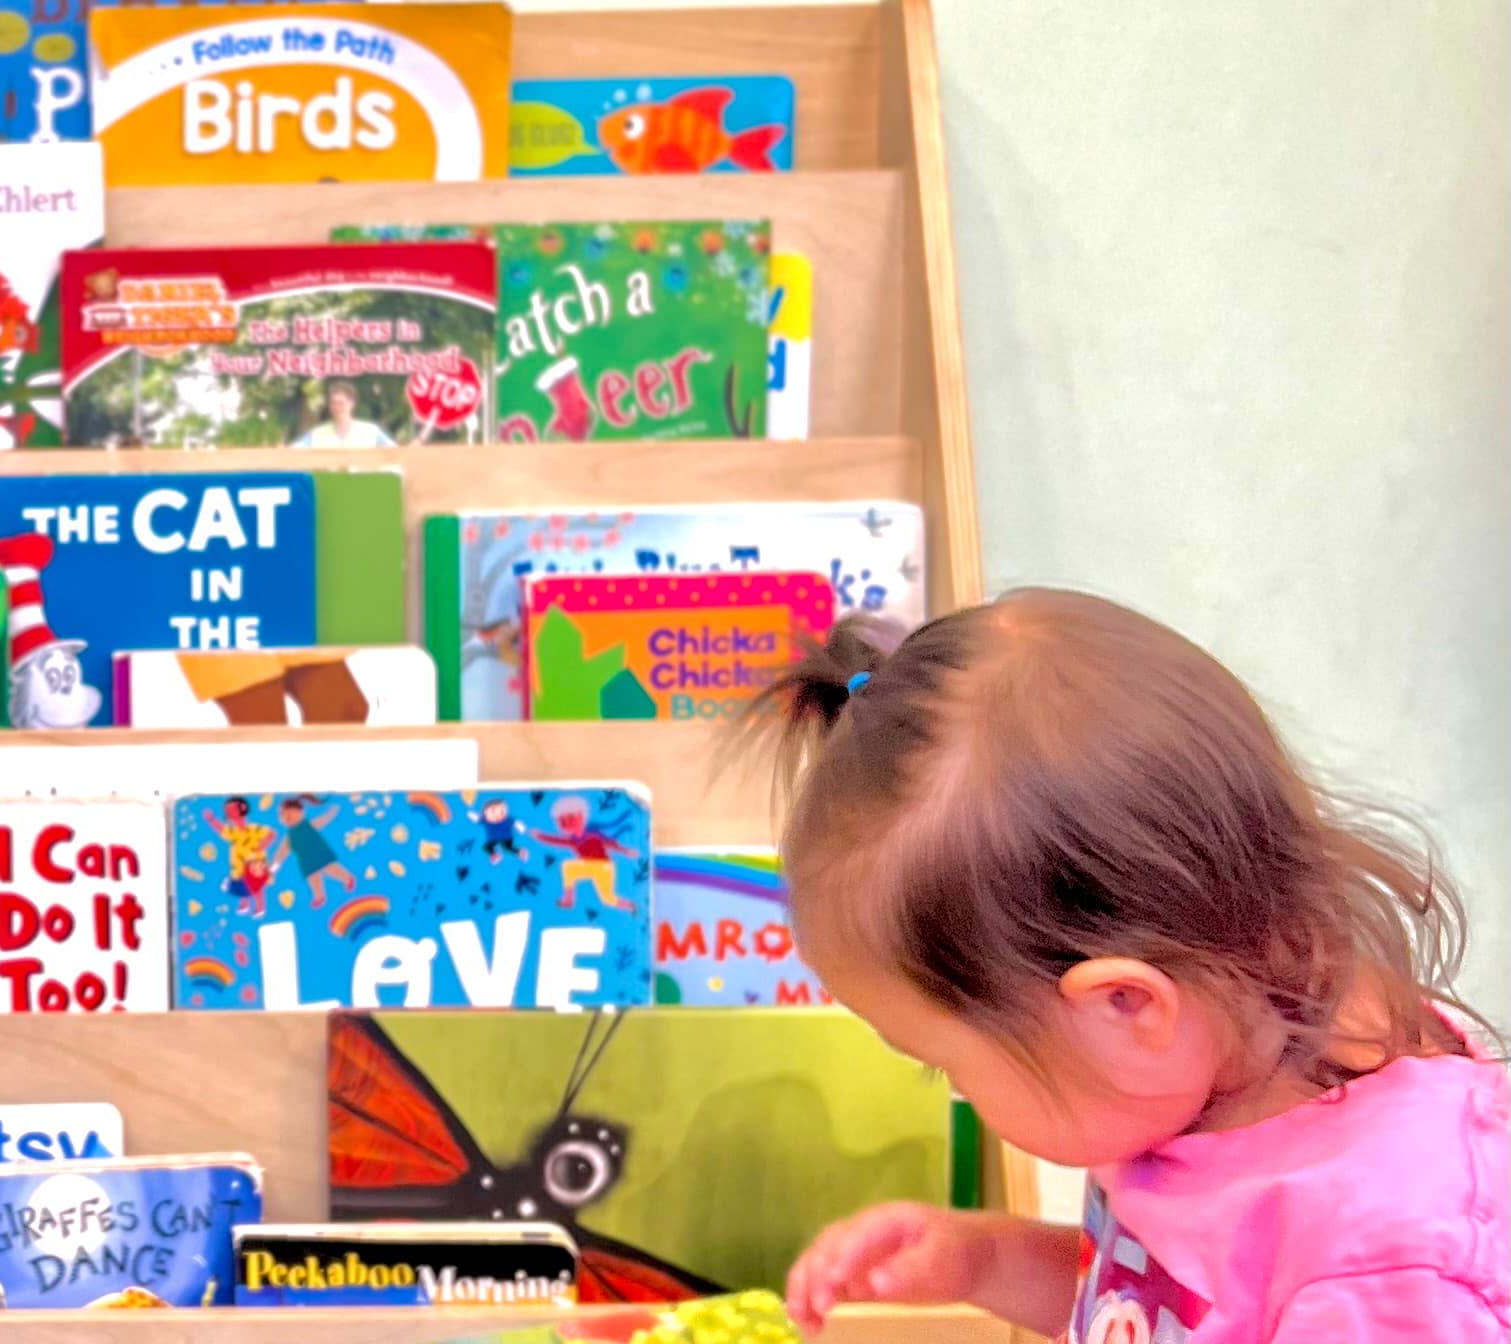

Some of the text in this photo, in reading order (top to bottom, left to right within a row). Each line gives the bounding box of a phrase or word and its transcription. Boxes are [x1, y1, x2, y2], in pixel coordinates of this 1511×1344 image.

[192, 26, 396, 65] Follow the Path
[183, 76, 397, 154] Birds
[293, 315, 392, 350] Helpers
[496, 264, 656, 371] atch a
[267, 345, 461, 377] Neighborhood
[411, 373, 478, 410] STOP
[22, 487, 292, 554] THE CAT
[190, 566, 243, 603] IN
[170, 616, 261, 649] THE
[647, 626, 776, 657] Chicka
[671, 693, 753, 721] Boo
[31, 823, 140, 884] Can
[92, 892, 145, 952] It
[27, 1244, 176, 1294] DANCE
[243, 1249, 574, 1306] Peekaboo Morning
